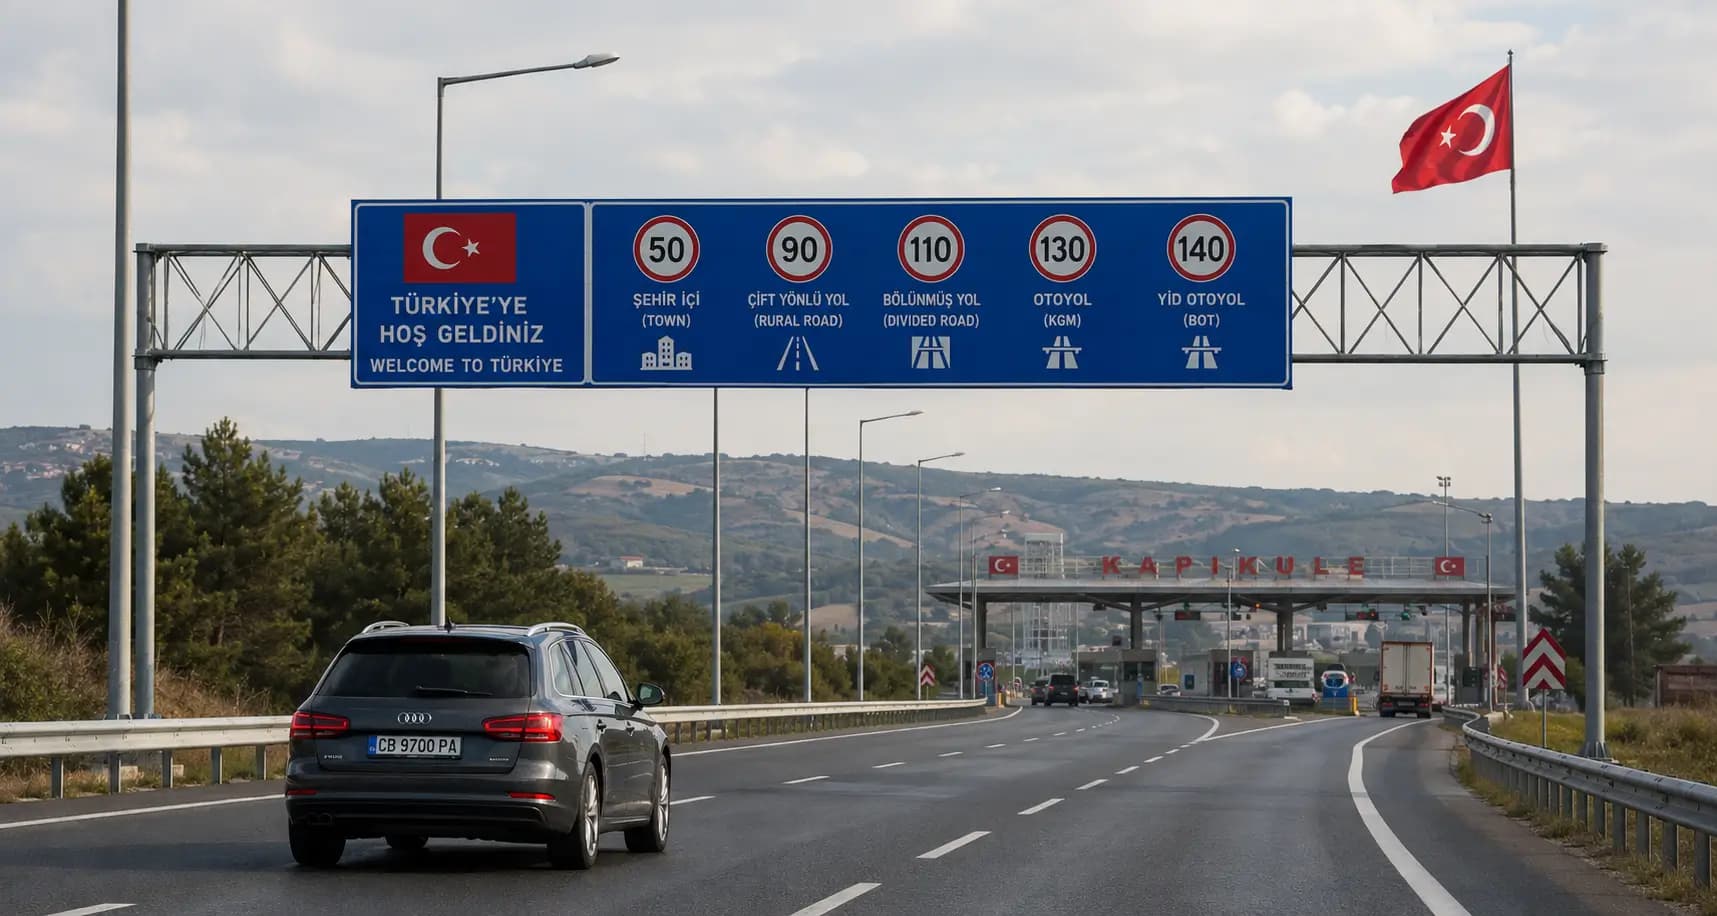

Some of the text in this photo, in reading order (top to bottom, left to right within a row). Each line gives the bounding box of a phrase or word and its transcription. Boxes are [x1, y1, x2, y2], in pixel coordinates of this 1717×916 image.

[648, 235, 685, 264] 50
[781, 235, 818, 264] 90
[910, 235, 952, 263] 110
[1040, 235, 1086, 263] 130
[1177, 234, 1225, 263] 140
[632, 290, 700, 309] ŞEHİR İÇİ
[747, 290, 850, 309] ÇİFT YÖNLÜ YOL
[883, 290, 981, 309] BÖLÜNMÜŞ YOL
[1033, 293, 1092, 306] OTOYOL
[1158, 290, 1246, 306] YİD OTOYOL
[642, 313, 691, 328] (TOWN)
[754, 313, 844, 329] (RURAL ROAD)
[883, 313, 980, 329] (DIVIDED ROAD)
[1043, 313, 1081, 329] (KGM)
[1183, 313, 1221, 328] (BOT)
[380, 319, 544, 347] HOŞ GELDİNİZ
[370, 354, 563, 373] WELCOME TO TÜRKİYE
[1101, 555, 1365, 576] KAPIKULE
[378, 737, 457, 754] CB 9700 PA
